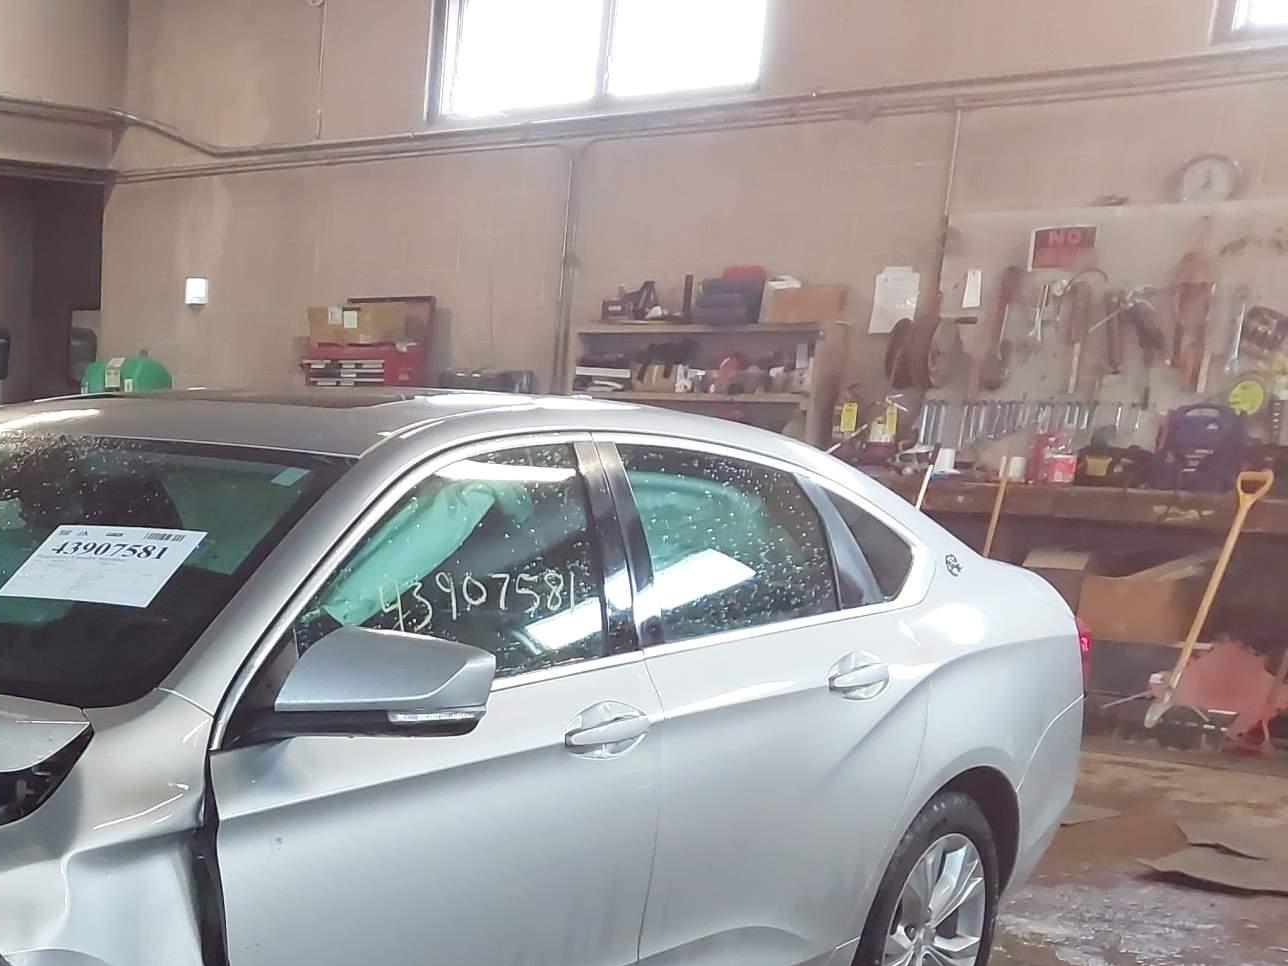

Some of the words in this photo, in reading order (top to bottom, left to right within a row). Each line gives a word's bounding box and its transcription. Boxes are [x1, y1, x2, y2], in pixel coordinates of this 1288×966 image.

[1049, 228, 1081, 245] NO
[51, 541, 169, 560] 43907581
[379, 571, 575, 632] 43907581
